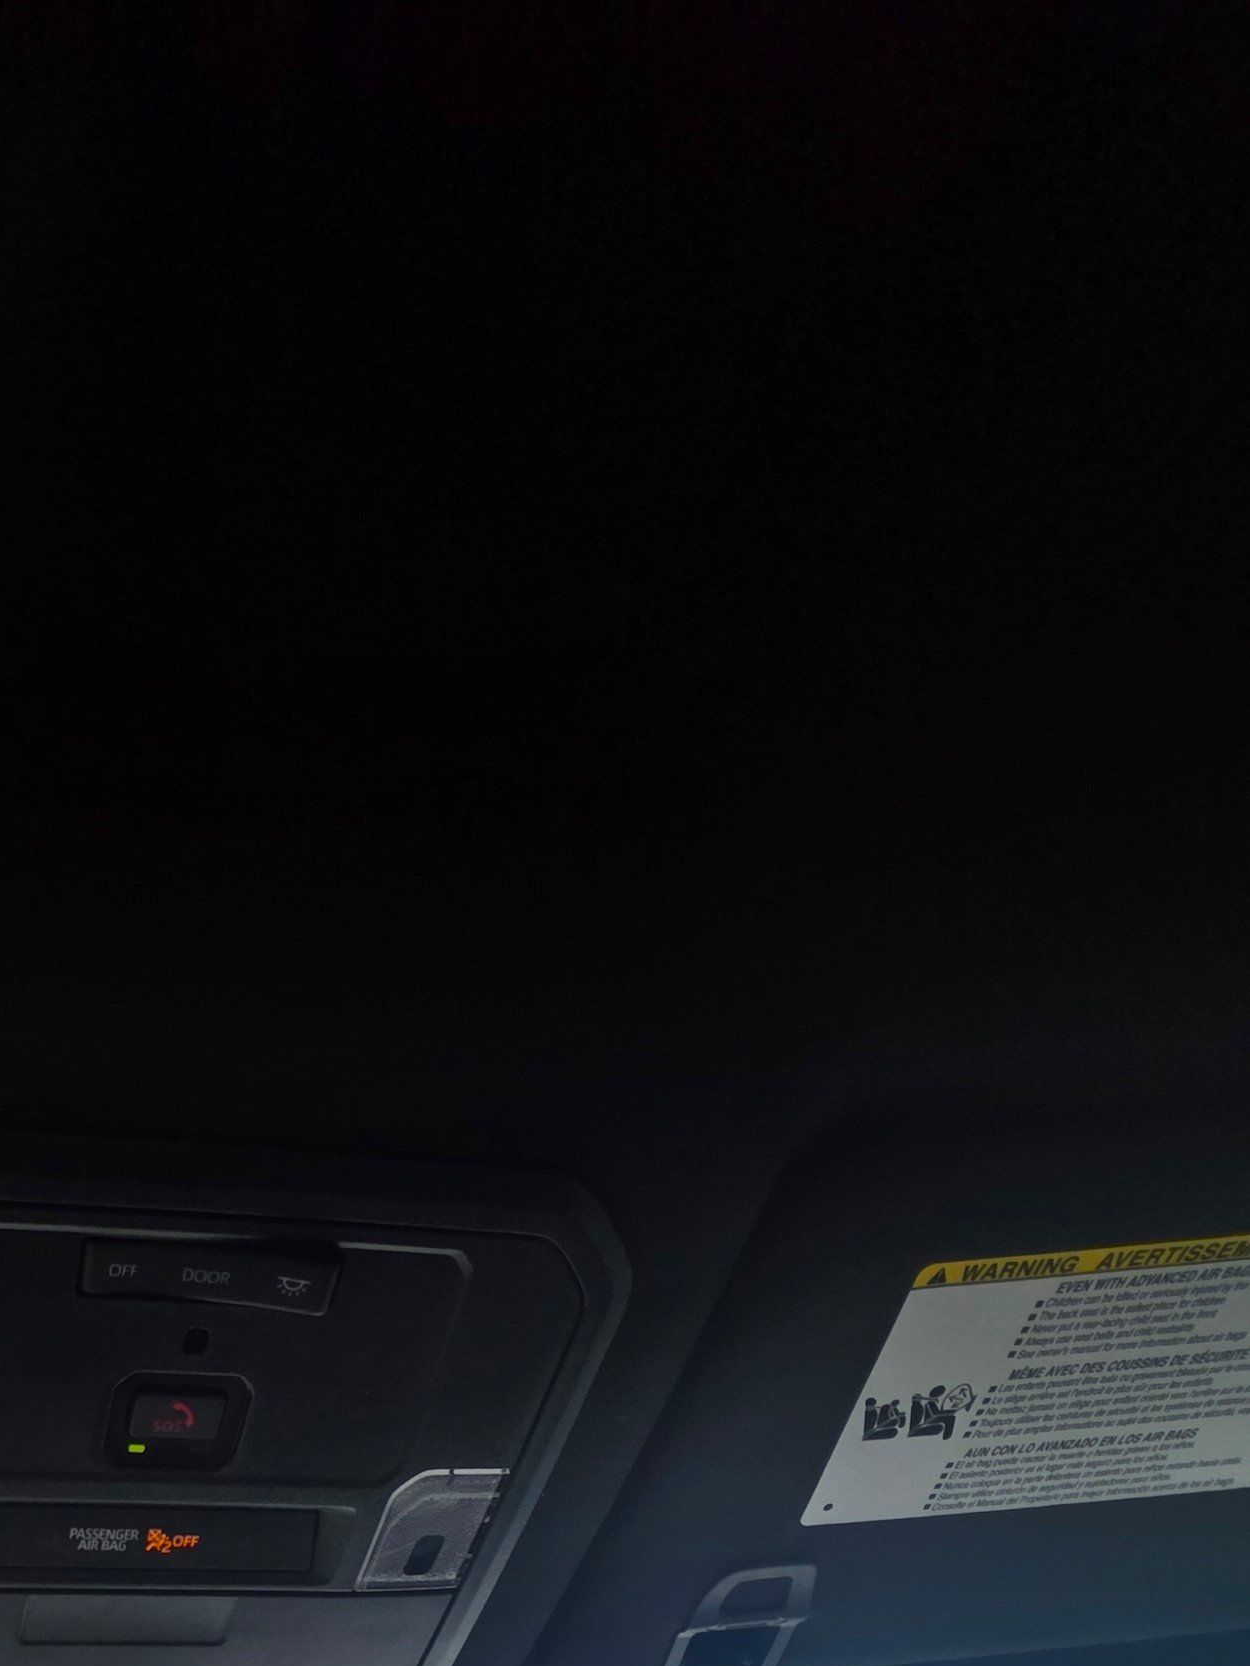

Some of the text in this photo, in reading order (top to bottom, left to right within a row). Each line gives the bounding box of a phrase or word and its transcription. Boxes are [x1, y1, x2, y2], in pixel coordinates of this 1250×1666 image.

[108, 1263, 140, 1278] OFF
[182, 1267, 231, 1286] DOOR
[961, 1255, 1080, 1282] WARNING
[1057, 1279, 1094, 1292] EVEN
[1093, 1276, 1128, 1289] WITH
[1127, 1270, 1198, 1286] ADVANCED
[1198, 1268, 1222, 1280] AIR
[1009, 1365, 1047, 1379] MÊME
[1046, 1364, 1079, 1375] AVEC
[1080, 1362, 1106, 1372] DES
[1107, 1356, 1170, 1370] COUSSINS
[1170, 1355, 1189, 1364] DE
[153, 1420, 182, 1433] SOS
[964, 1428, 1199, 1457] AUN CON LO AVANZADO EN LOS AIR BAGS
[68, 1526, 141, 1542] PASSENGER
[172, 1534, 200, 1548] OFF
[76, 1538, 128, 1552] AIR BAG
